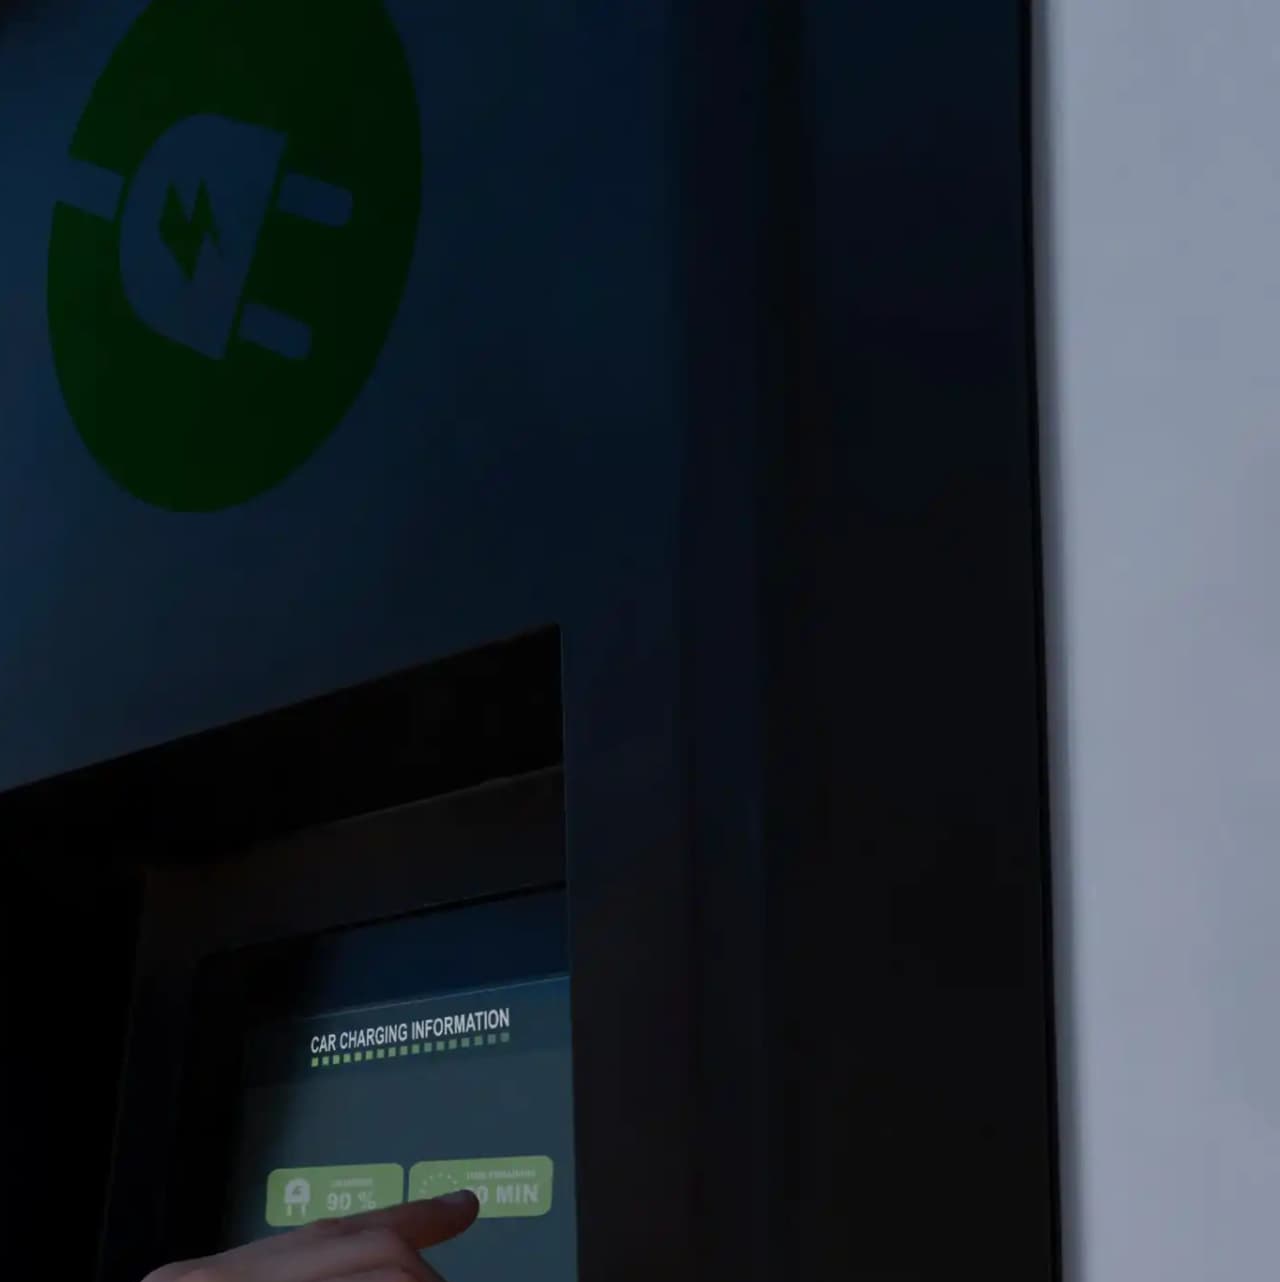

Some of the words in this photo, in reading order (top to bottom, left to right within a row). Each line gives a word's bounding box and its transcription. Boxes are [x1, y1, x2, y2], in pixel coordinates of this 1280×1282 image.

[311, 1033, 336, 1053] CAR
[340, 1023, 407, 1049] CHARGING
[412, 1007, 510, 1040] INFORMATION
[327, 1193, 351, 1211] 90
[496, 1183, 539, 1204] MIN
